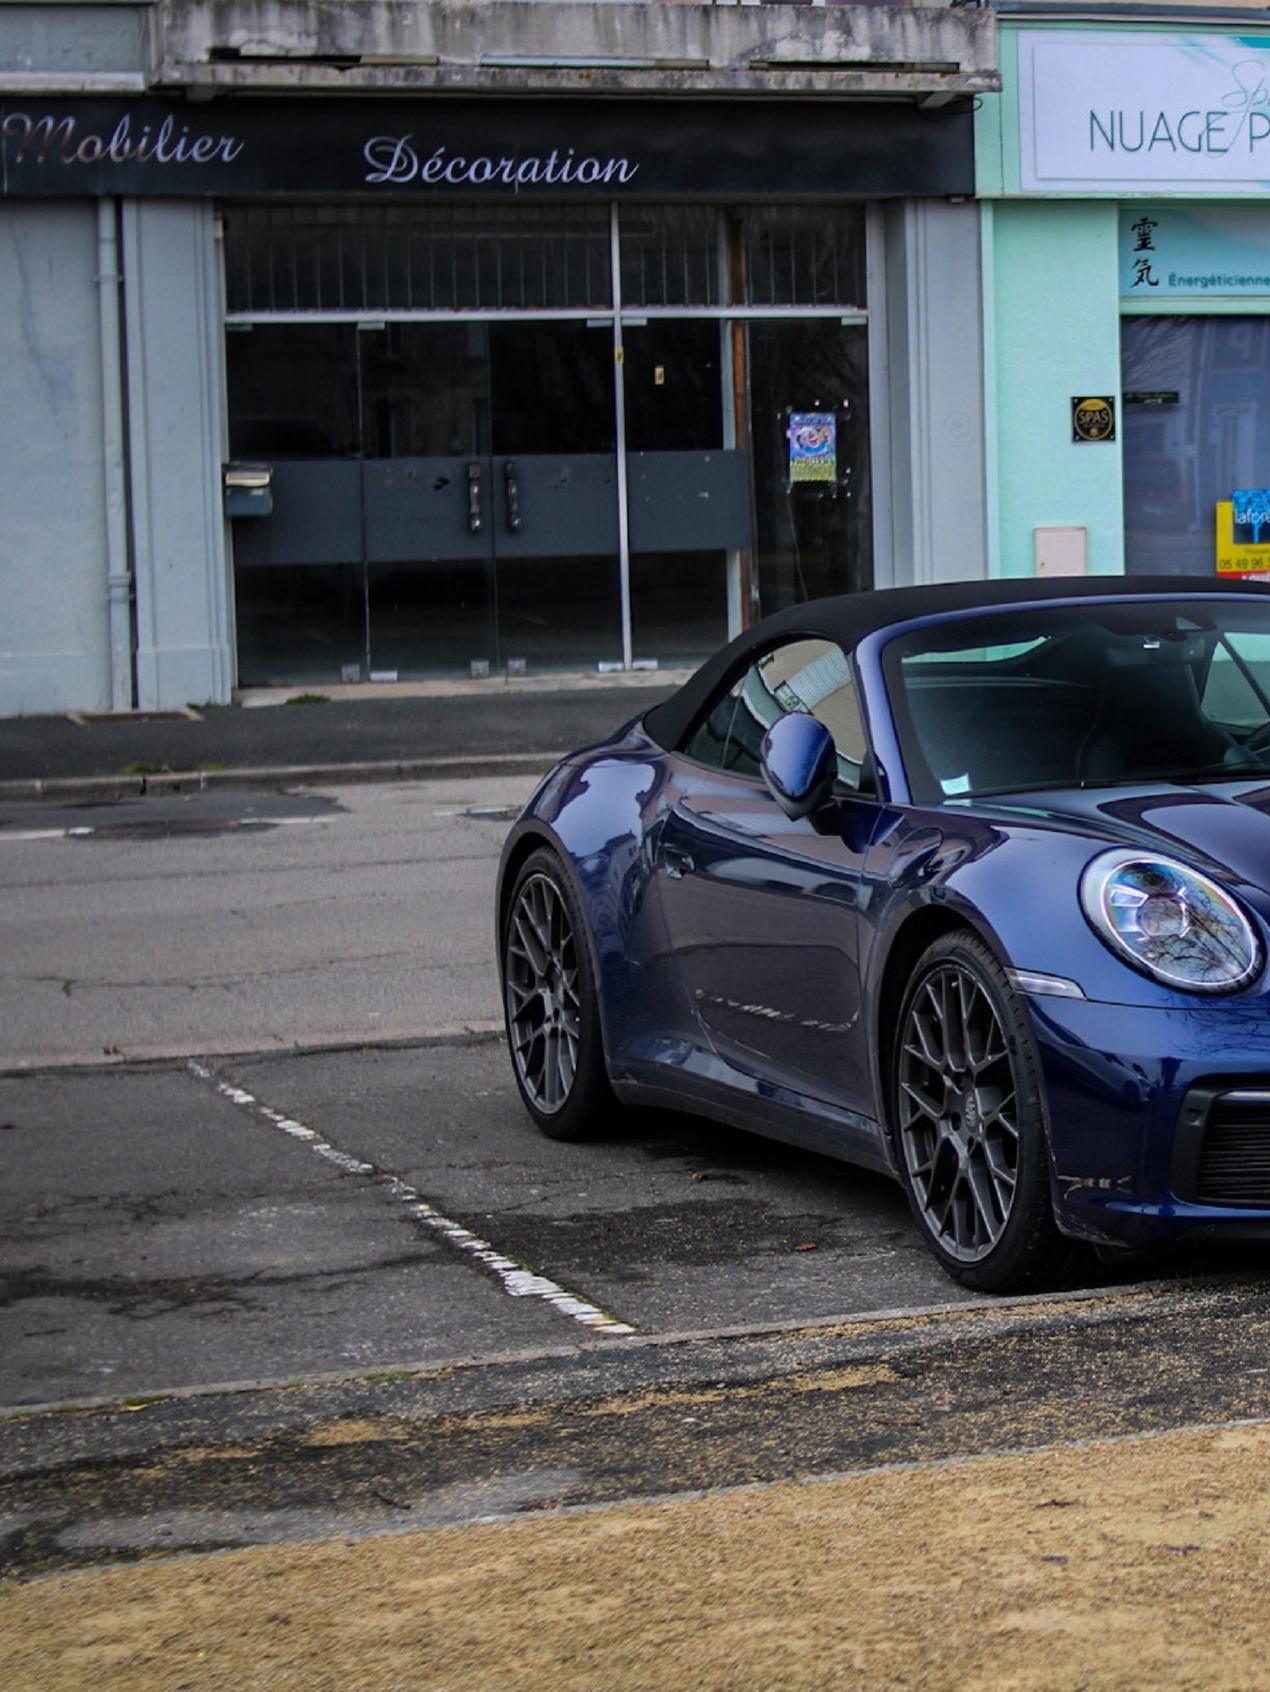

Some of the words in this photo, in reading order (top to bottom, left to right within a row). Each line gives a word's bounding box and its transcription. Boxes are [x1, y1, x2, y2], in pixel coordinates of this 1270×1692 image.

[2, 111, 245, 165] Mobilier
[1088, 109, 1229, 153] NUAGE
[363, 132, 640, 184] Décoration
[1078, 411, 1109, 424] SPAS
[1219, 559, 1232, 569] 05
[1235, 558, 1248, 568] 49
[1252, 557, 1264, 568] 96
